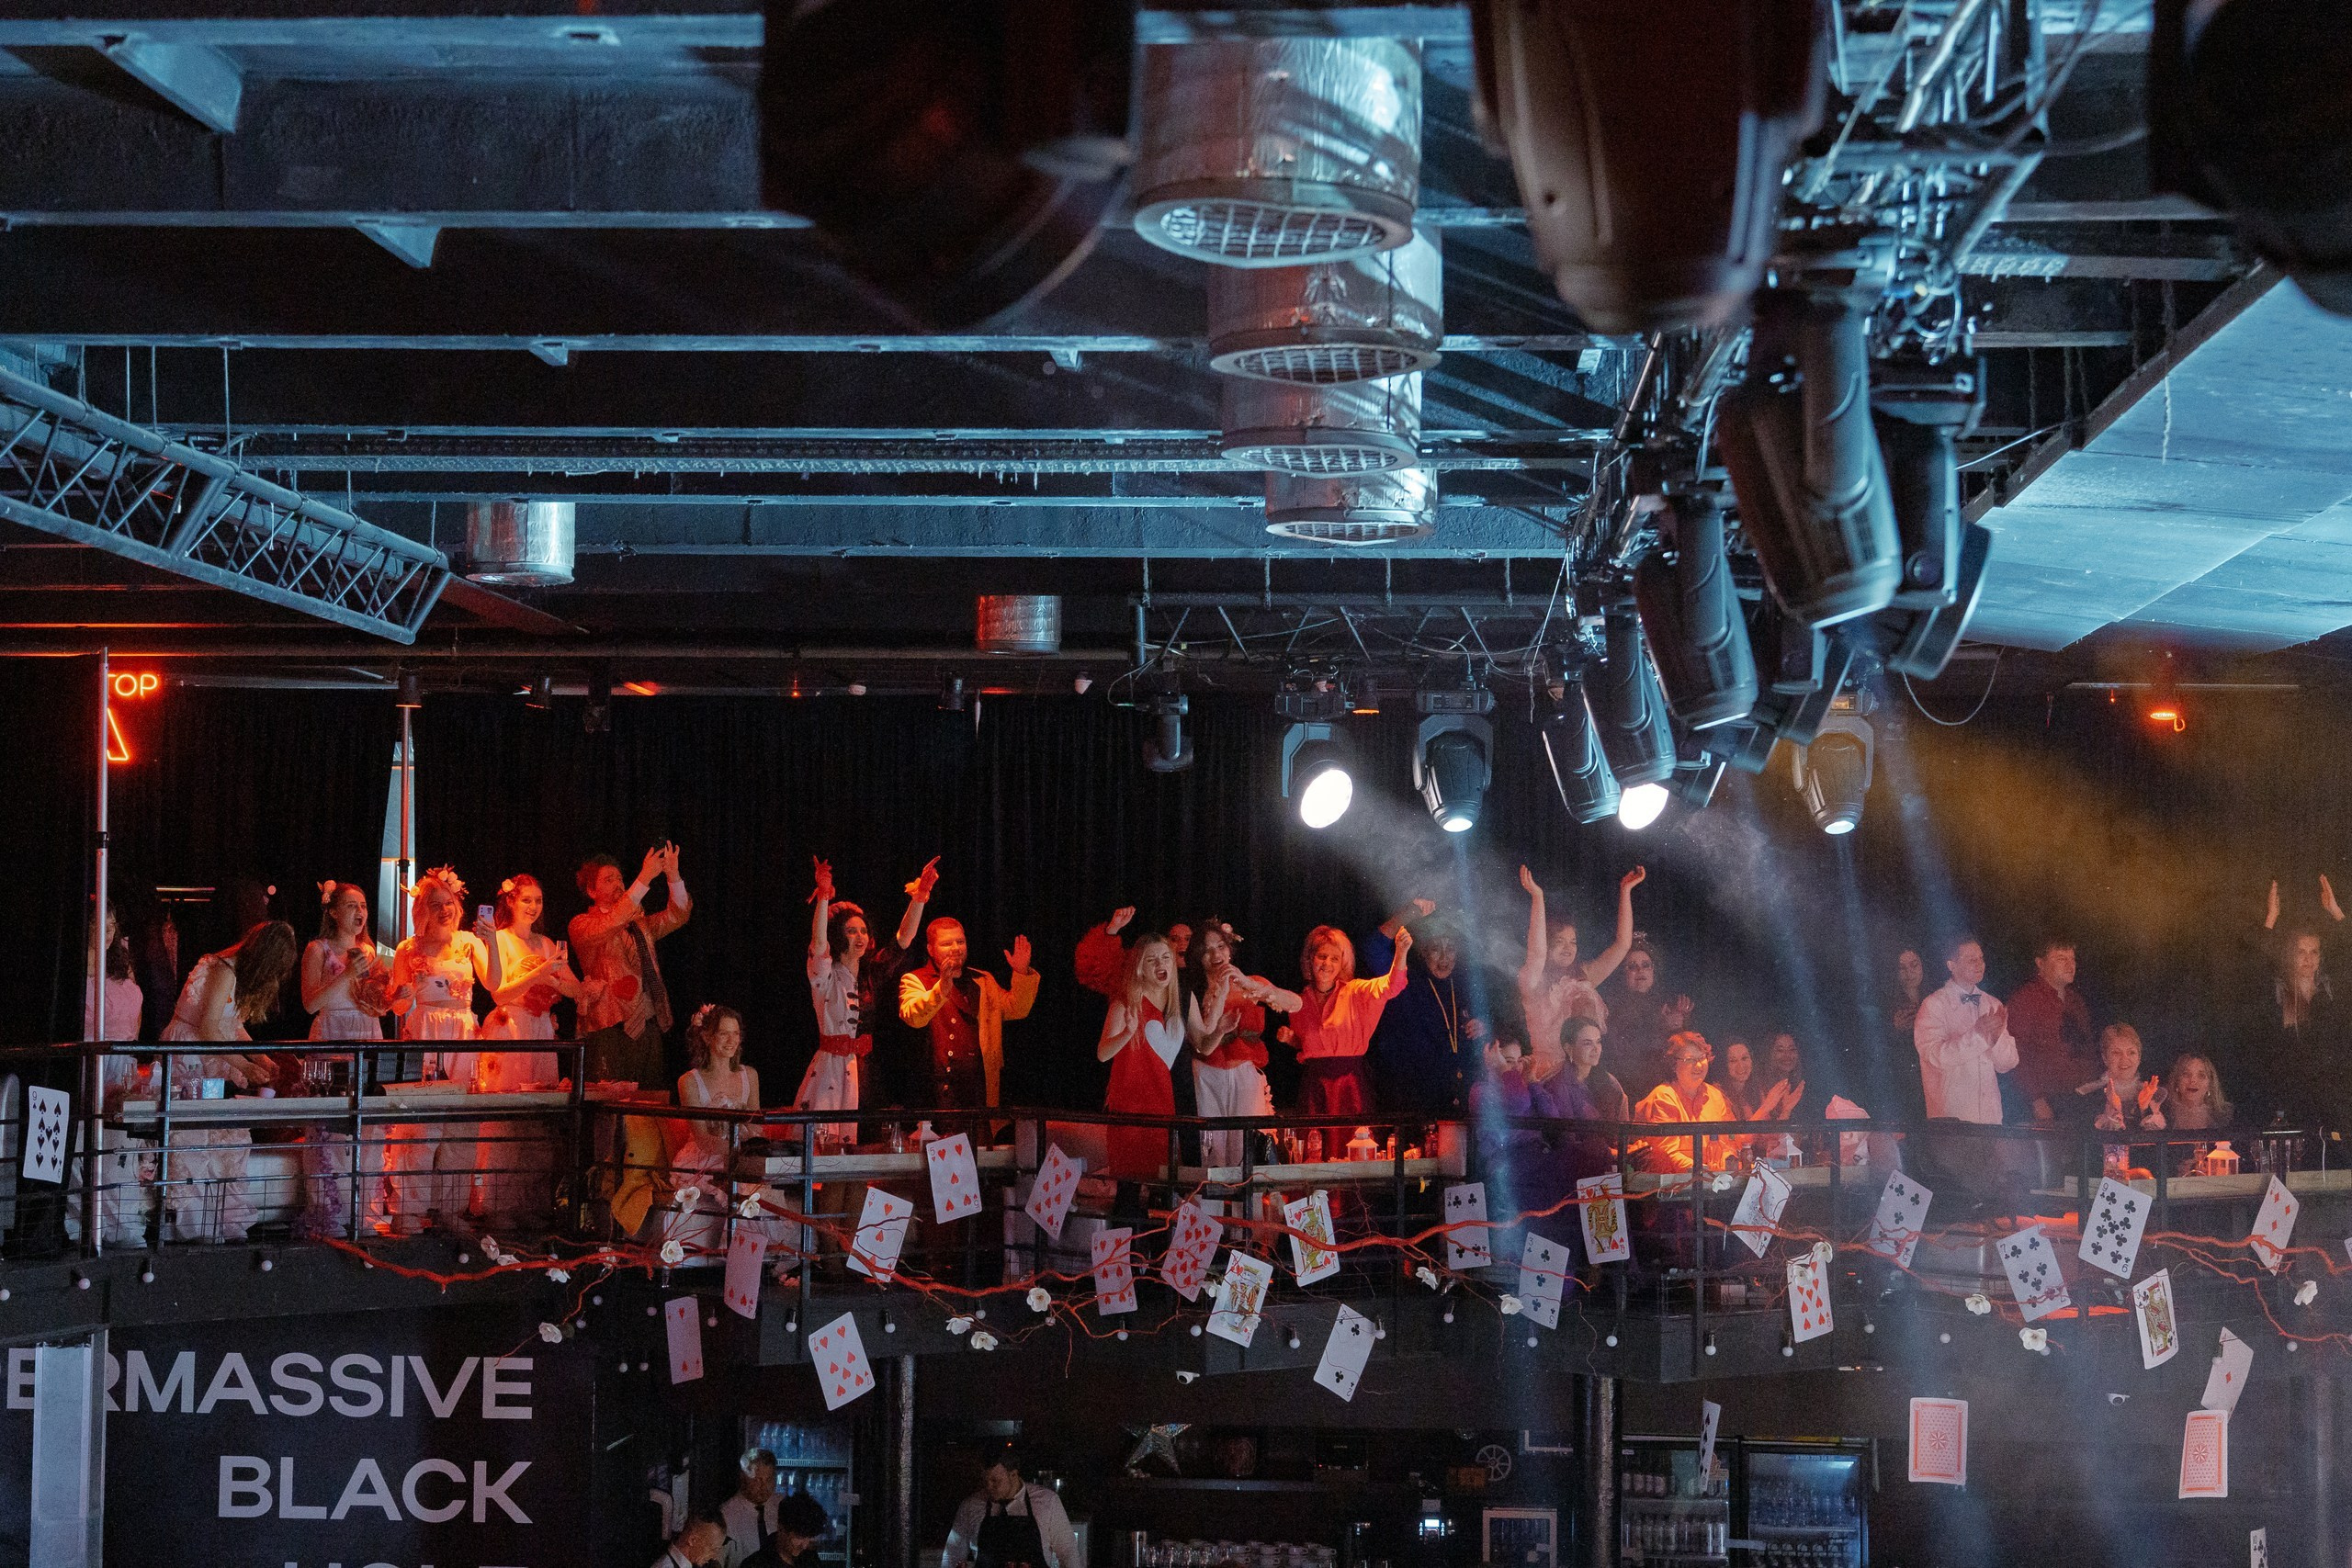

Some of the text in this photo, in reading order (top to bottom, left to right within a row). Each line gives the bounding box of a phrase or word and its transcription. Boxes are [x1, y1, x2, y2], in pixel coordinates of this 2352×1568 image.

[31, 1090, 38, 1101] 9
[929, 1146, 936, 1156] 5
[1891, 1175, 1898, 1183] 5
[2101, 1182, 2109, 1192] 9
[869, 1191, 876, 1201] 3
[973, 1199, 979, 1209] 5
[1288, 1208, 1294, 1219] J
[1529, 1236, 1534, 1247] 3
[1999, 1243, 2007, 1253] 7
[2120, 1263, 2129, 1273] 9
[810, 1337, 817, 1346] 7
[1346, 1387, 1353, 1397] 2
[219, 1456, 533, 1524] BLACK
